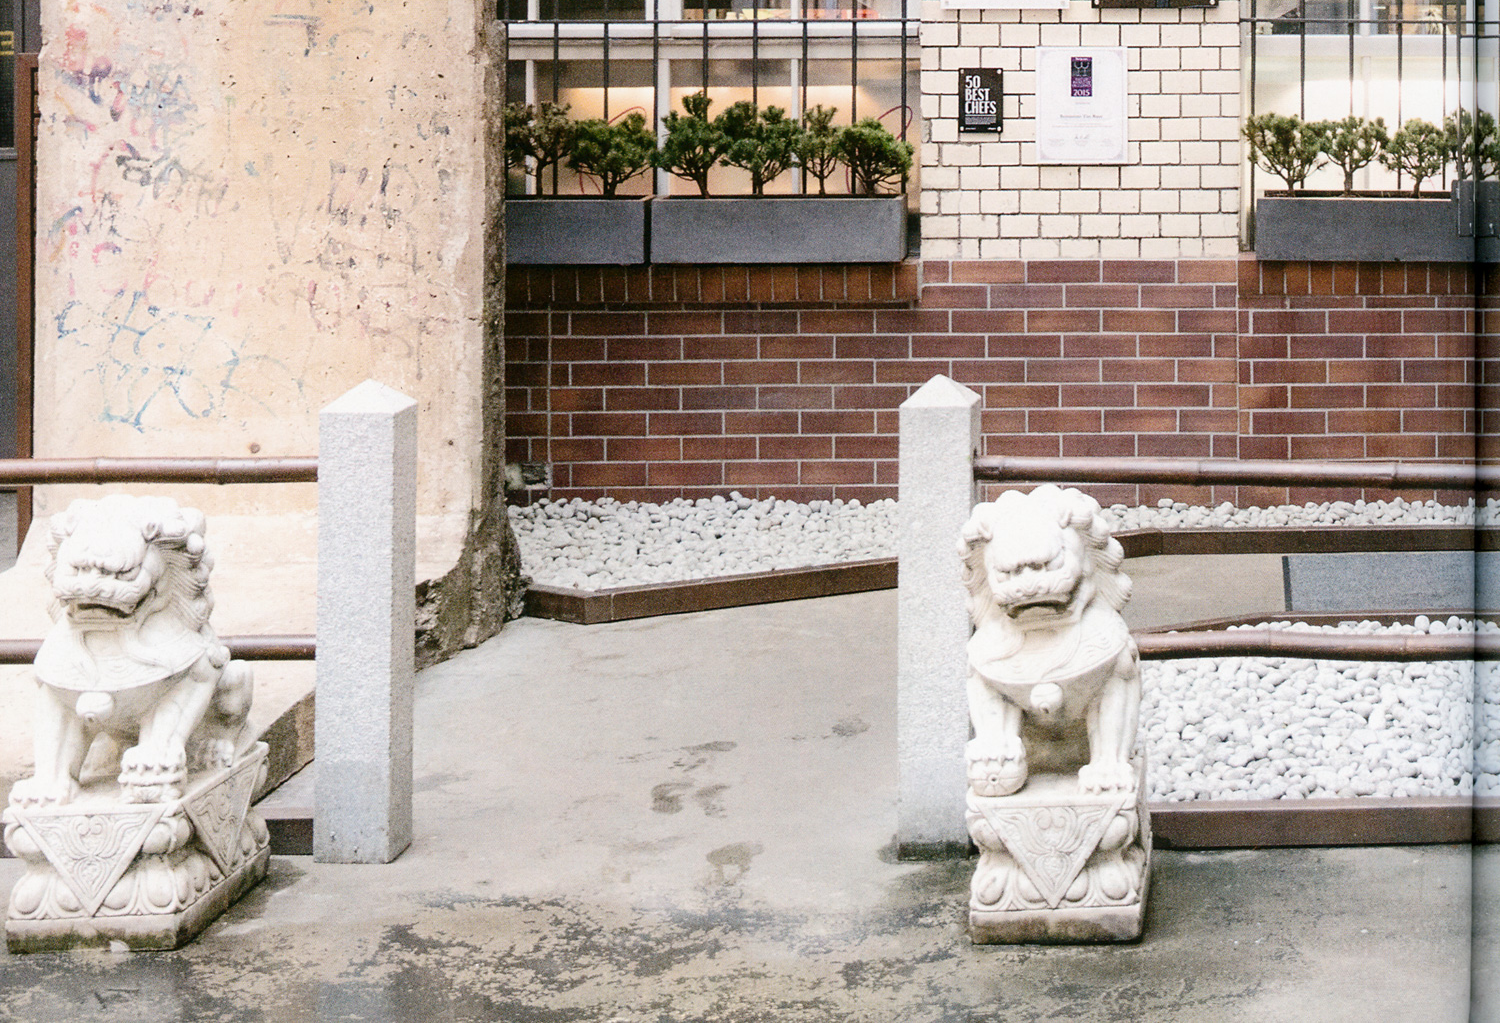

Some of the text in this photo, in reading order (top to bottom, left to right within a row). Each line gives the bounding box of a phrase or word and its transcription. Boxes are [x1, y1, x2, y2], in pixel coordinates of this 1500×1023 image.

[965, 75, 981, 89] 50
[965, 88, 990, 101] BEST
[1073, 88, 1090, 96] 2015
[965, 100, 997, 114] CHEFS
